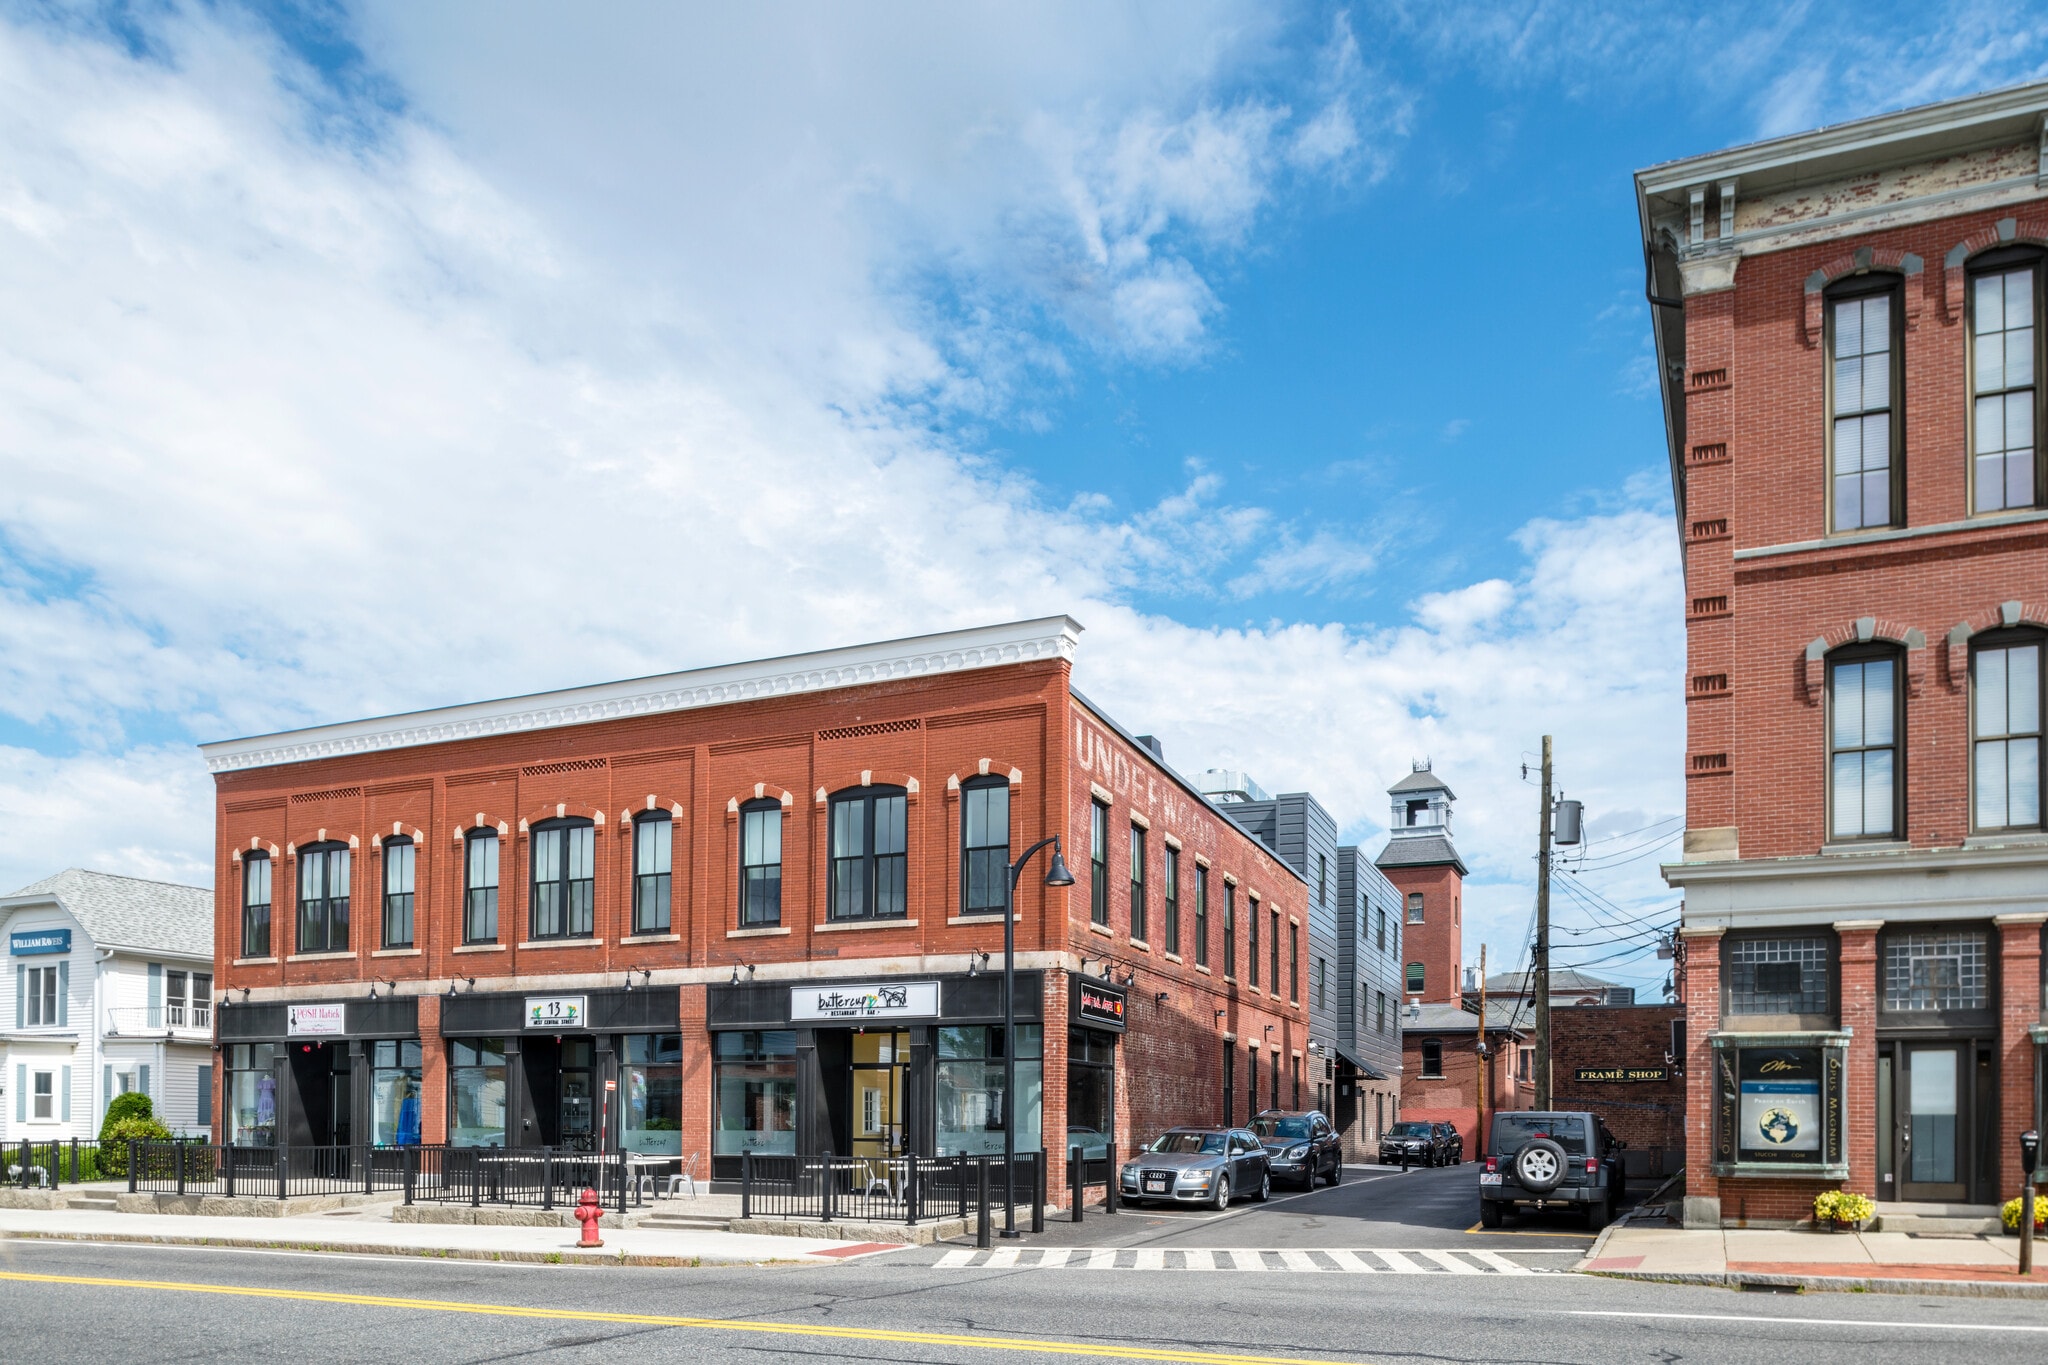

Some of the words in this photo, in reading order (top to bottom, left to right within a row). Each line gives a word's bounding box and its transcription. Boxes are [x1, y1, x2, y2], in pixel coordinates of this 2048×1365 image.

[12, 937, 40, 948] WILLIAM
[41, 936, 63, 947] RAVEIS
[548, 1001, 560, 1017] 13
[818, 992, 867, 1015] buttercup
[297, 1008, 317, 1019] POSH
[1580, 1071, 1625, 1079] FRAME
[1628, 1071, 1662, 1079] SHOP
[1829, 1058, 1838, 1091] OPUS
[1829, 1097, 1838, 1157] MAGNUM
